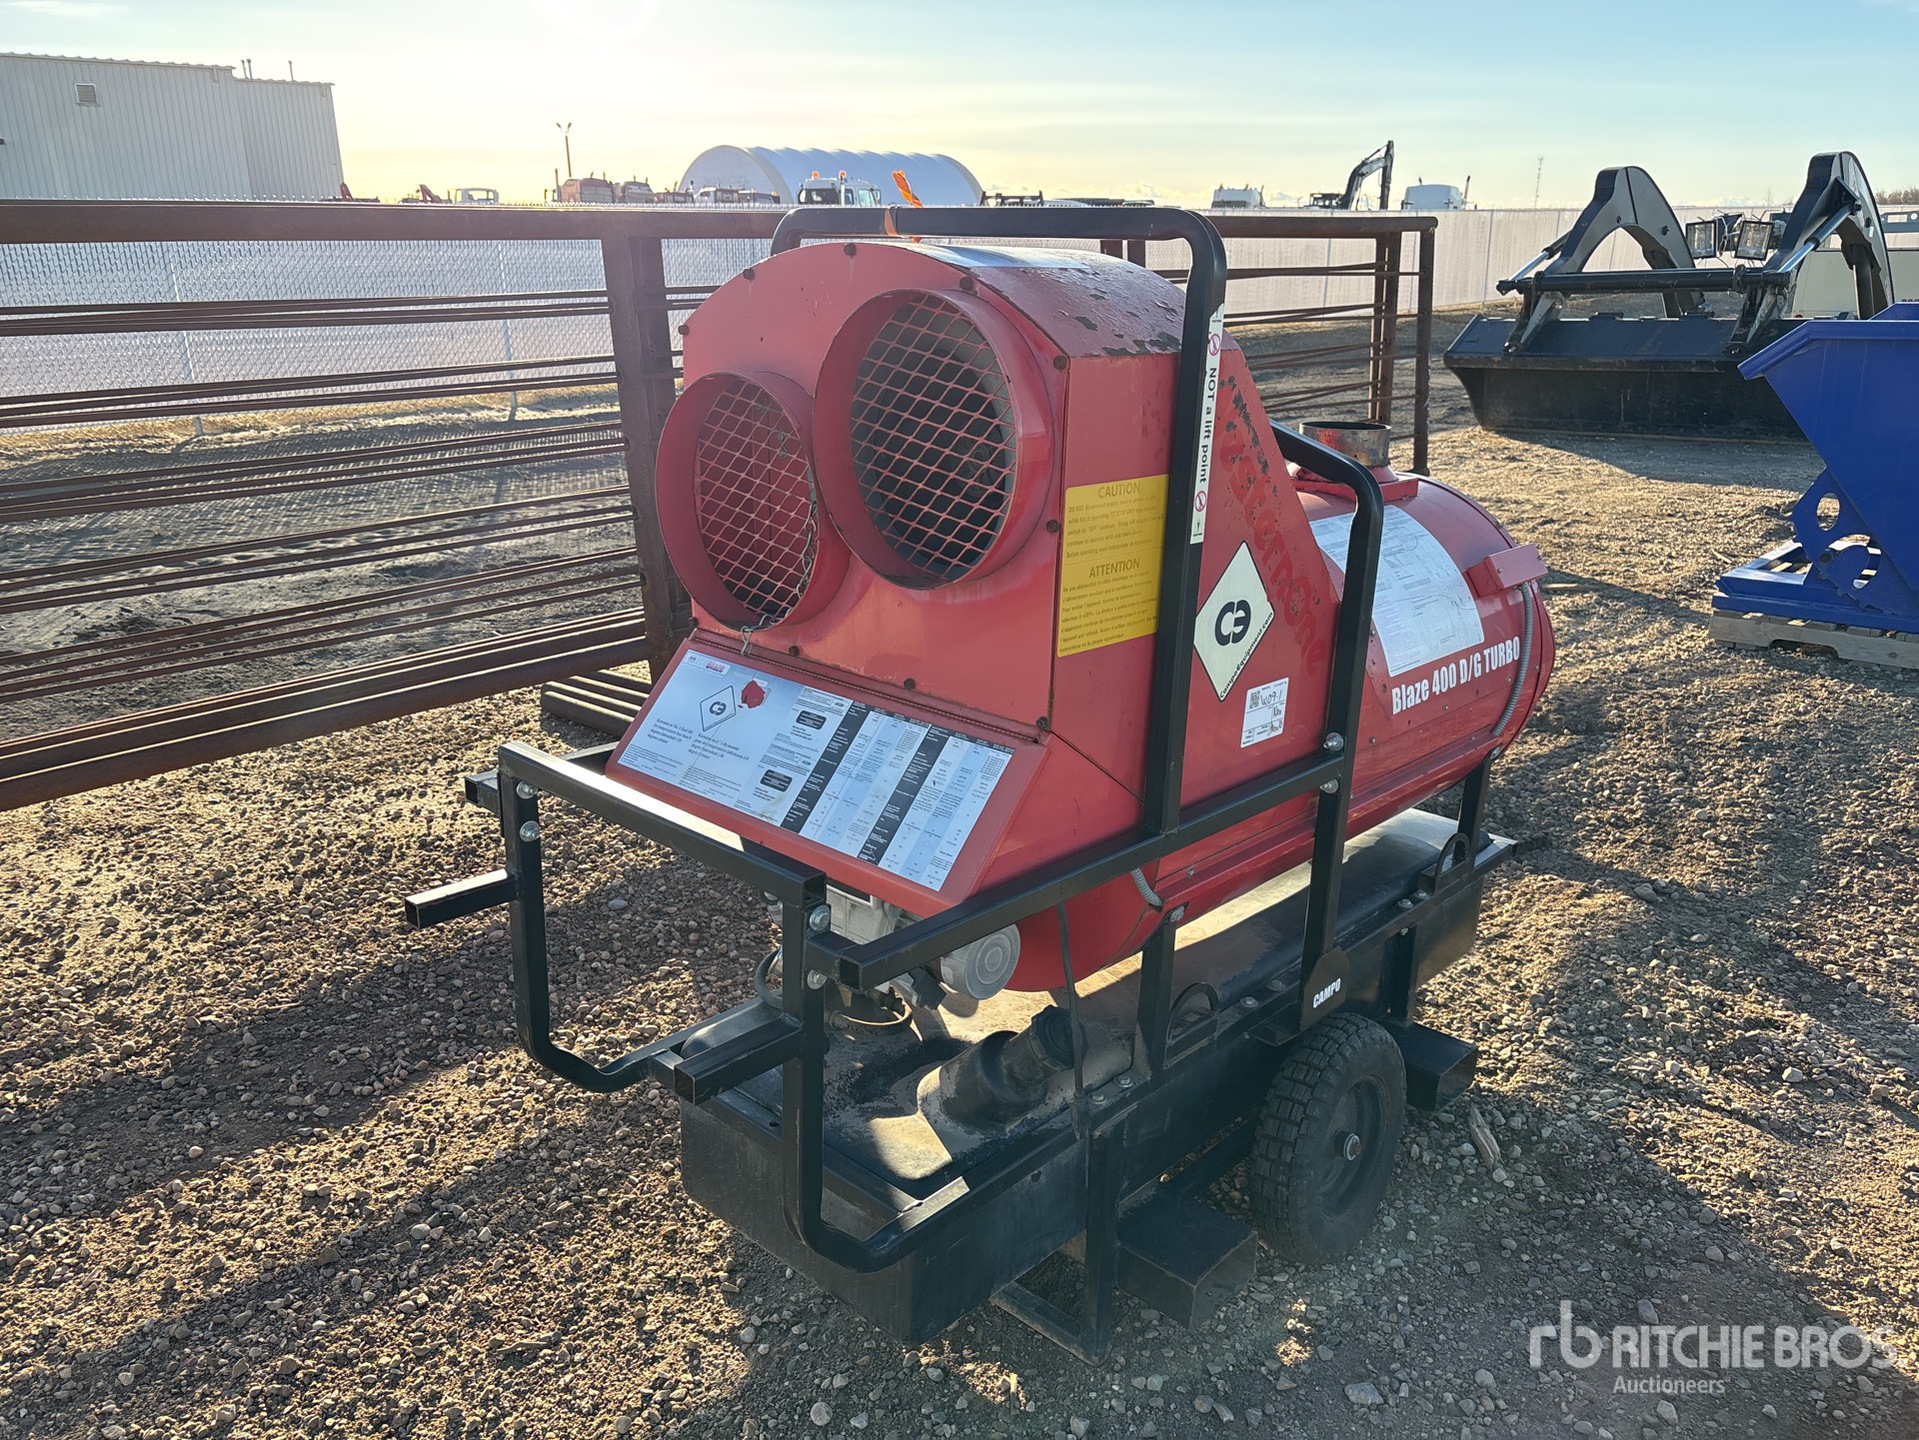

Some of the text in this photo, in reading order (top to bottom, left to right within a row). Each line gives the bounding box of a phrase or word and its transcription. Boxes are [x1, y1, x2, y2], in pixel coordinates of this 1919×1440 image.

[1200, 367, 1217, 484] NOT a lift point
[1098, 482, 1140, 498] CAUTION
[1089, 558, 1140, 578] ATTENTION
[1392, 636, 1521, 714] Blaze 400 D/G TURBO
[1313, 978, 1341, 1009] CAMPO
